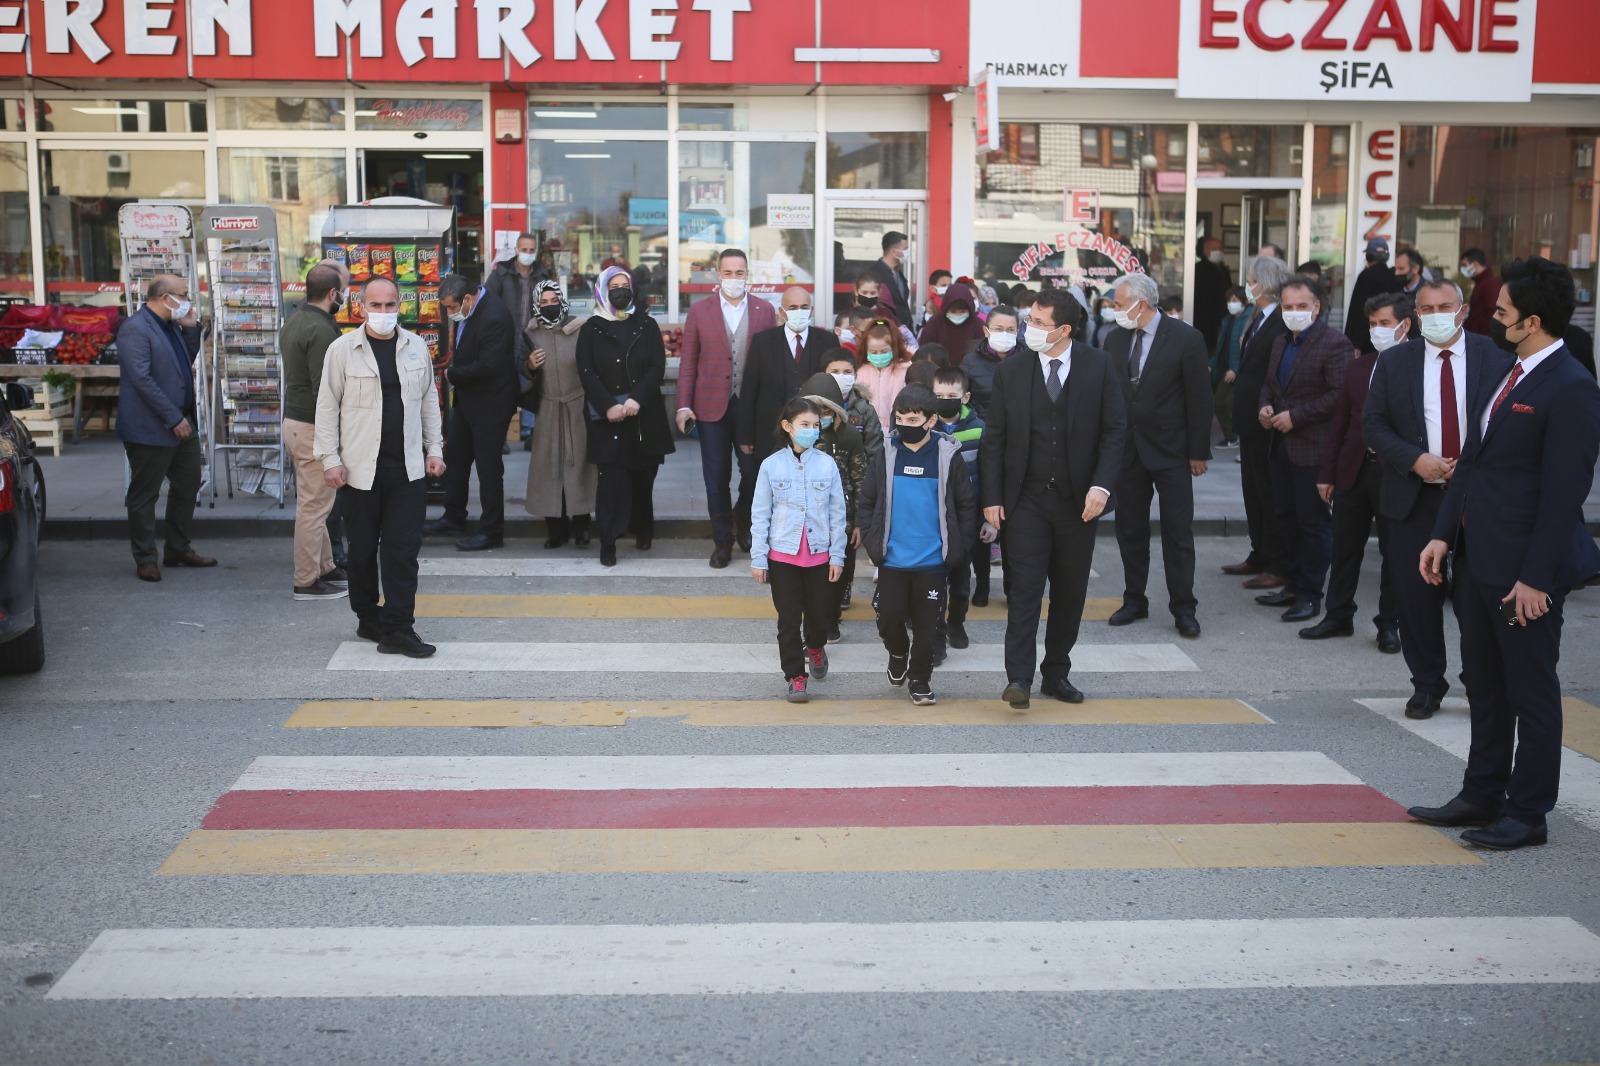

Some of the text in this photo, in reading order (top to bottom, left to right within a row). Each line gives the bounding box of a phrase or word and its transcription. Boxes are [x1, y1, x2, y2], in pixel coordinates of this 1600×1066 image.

[313, 0, 752, 69] MARKET
[1199, 0, 1519, 53] ECZANE
[373, 99, 470, 128] Hoşgeldiniz
[213, 218, 258, 230] Hürriyet
